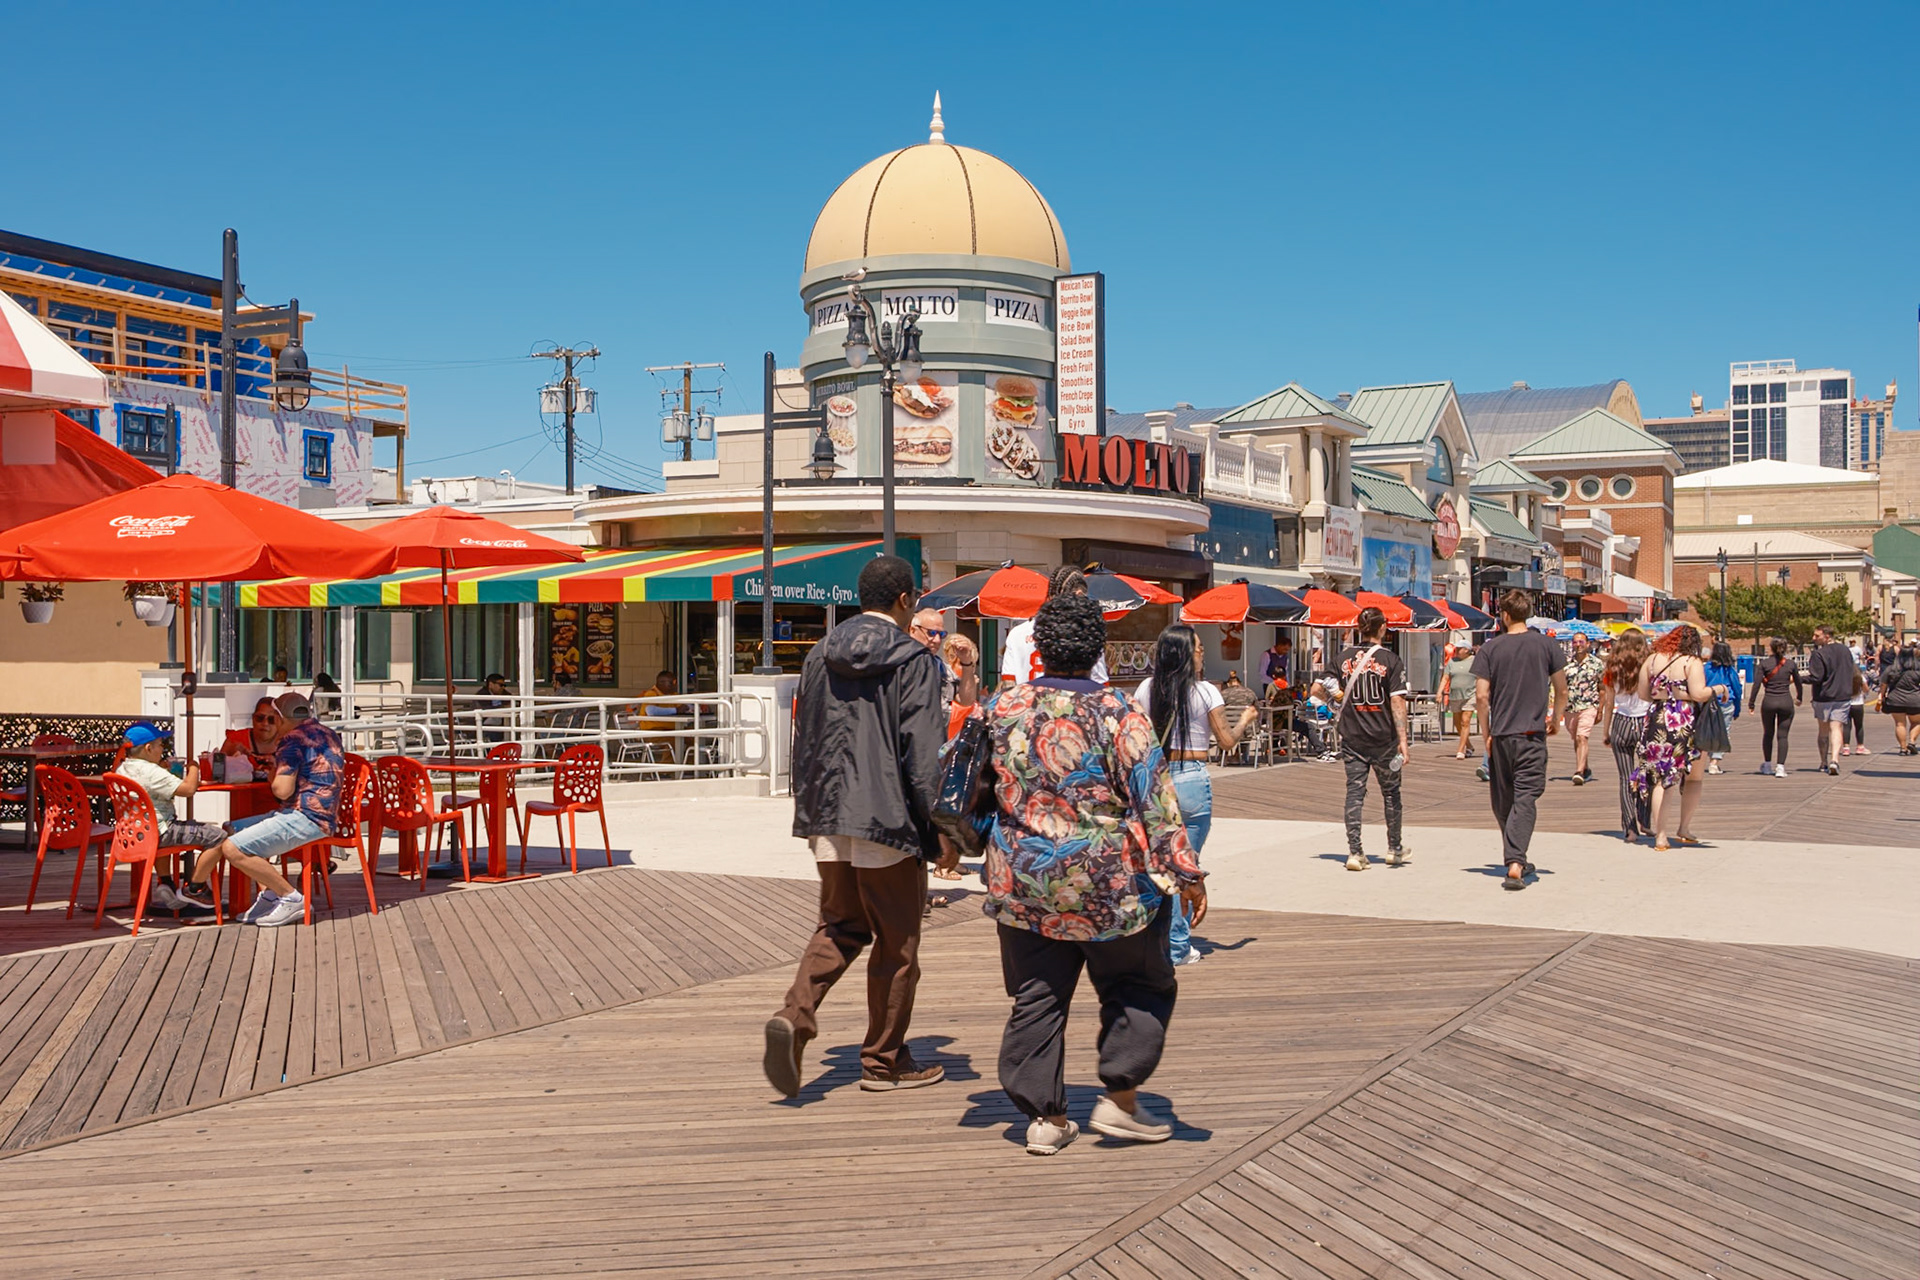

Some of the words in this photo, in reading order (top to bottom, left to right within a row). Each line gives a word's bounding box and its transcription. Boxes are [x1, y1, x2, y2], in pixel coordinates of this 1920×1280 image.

[1060, 281, 1080, 291] Mexican
[1081, 279, 1093, 289] Taco
[1060, 294, 1079, 305] Burrito
[1080, 292, 1093, 303] Bowl
[885, 295, 955, 316] MOLTO
[994, 297, 1040, 323] PIZZA
[1060, 308, 1079, 320] Veggie
[1080, 306, 1093, 317] Bowl
[1060, 322, 1075, 333] Rice
[1076, 320, 1093, 331] Bowl
[1060, 334, 1077, 346] Salad
[1078, 333, 1093, 344] Bowl
[1060, 350, 1071, 360] Ice
[1071, 349, 1093, 359] Cream
[1060, 363, 1077, 374] Fresh
[1078, 361, 1093, 372] Fruit
[1060, 376, 1093, 388] Smoothies
[1060, 391, 1078, 401] French
[1078, 390, 1093, 402] Crepe
[1060, 404, 1075, 417] Philly
[1075, 403, 1093, 415] Steaks
[1068, 418, 1086, 431] Gyro
[1060, 432, 1190, 494] MOLTO
[109, 515, 195, 527] Coca-Cola
[459, 538, 528, 548] Coca-Cola
[745, 578, 783, 597] Chien
[785, 584, 804, 599] over
[806, 583, 826, 600] Rice
[832, 585, 853, 604] Gyro
